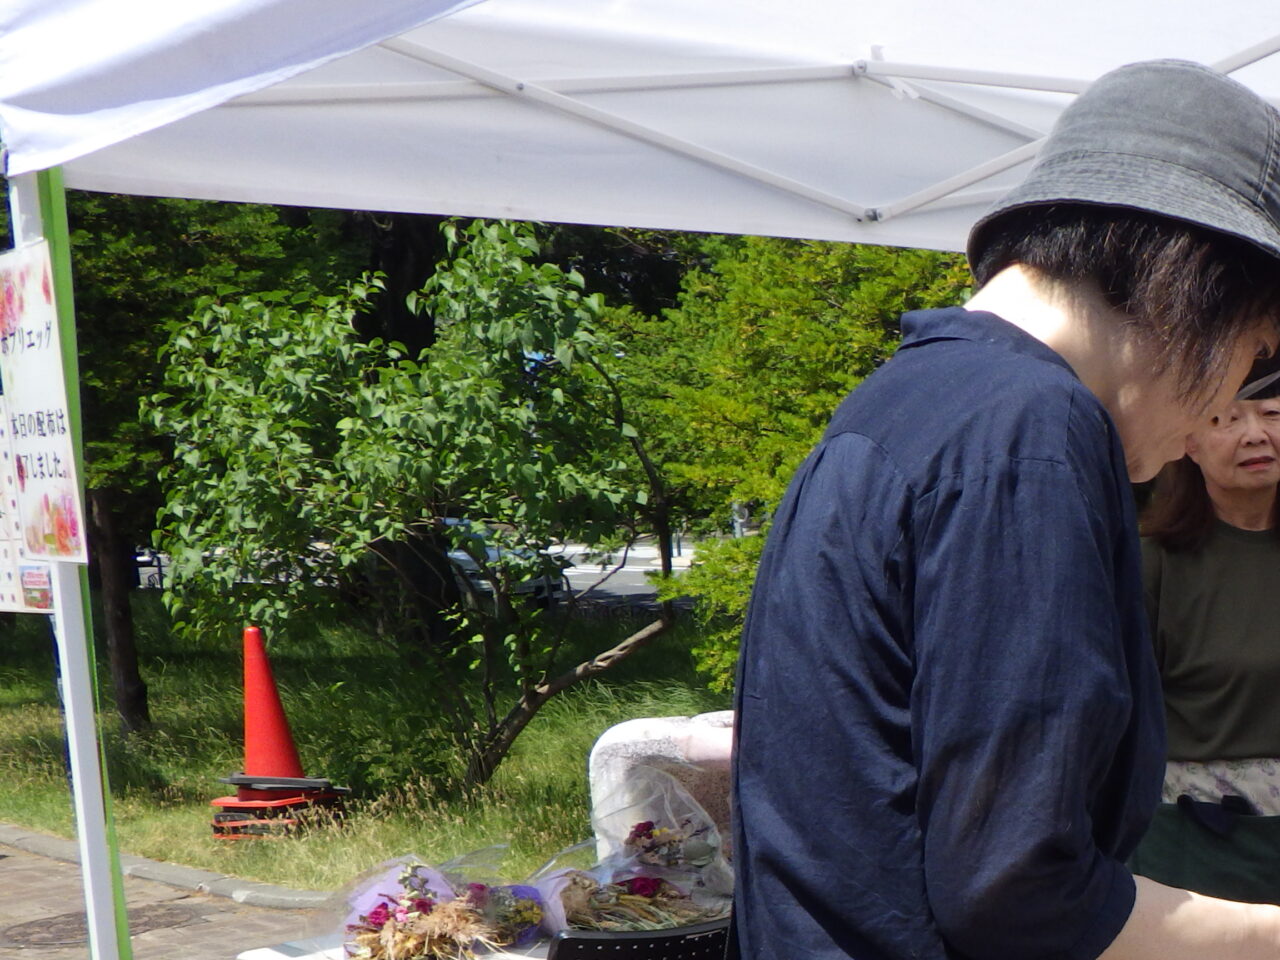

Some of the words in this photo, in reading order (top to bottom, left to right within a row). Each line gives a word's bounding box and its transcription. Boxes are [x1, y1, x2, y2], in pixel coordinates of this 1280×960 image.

[16, 451, 67, 483] 了しました。
